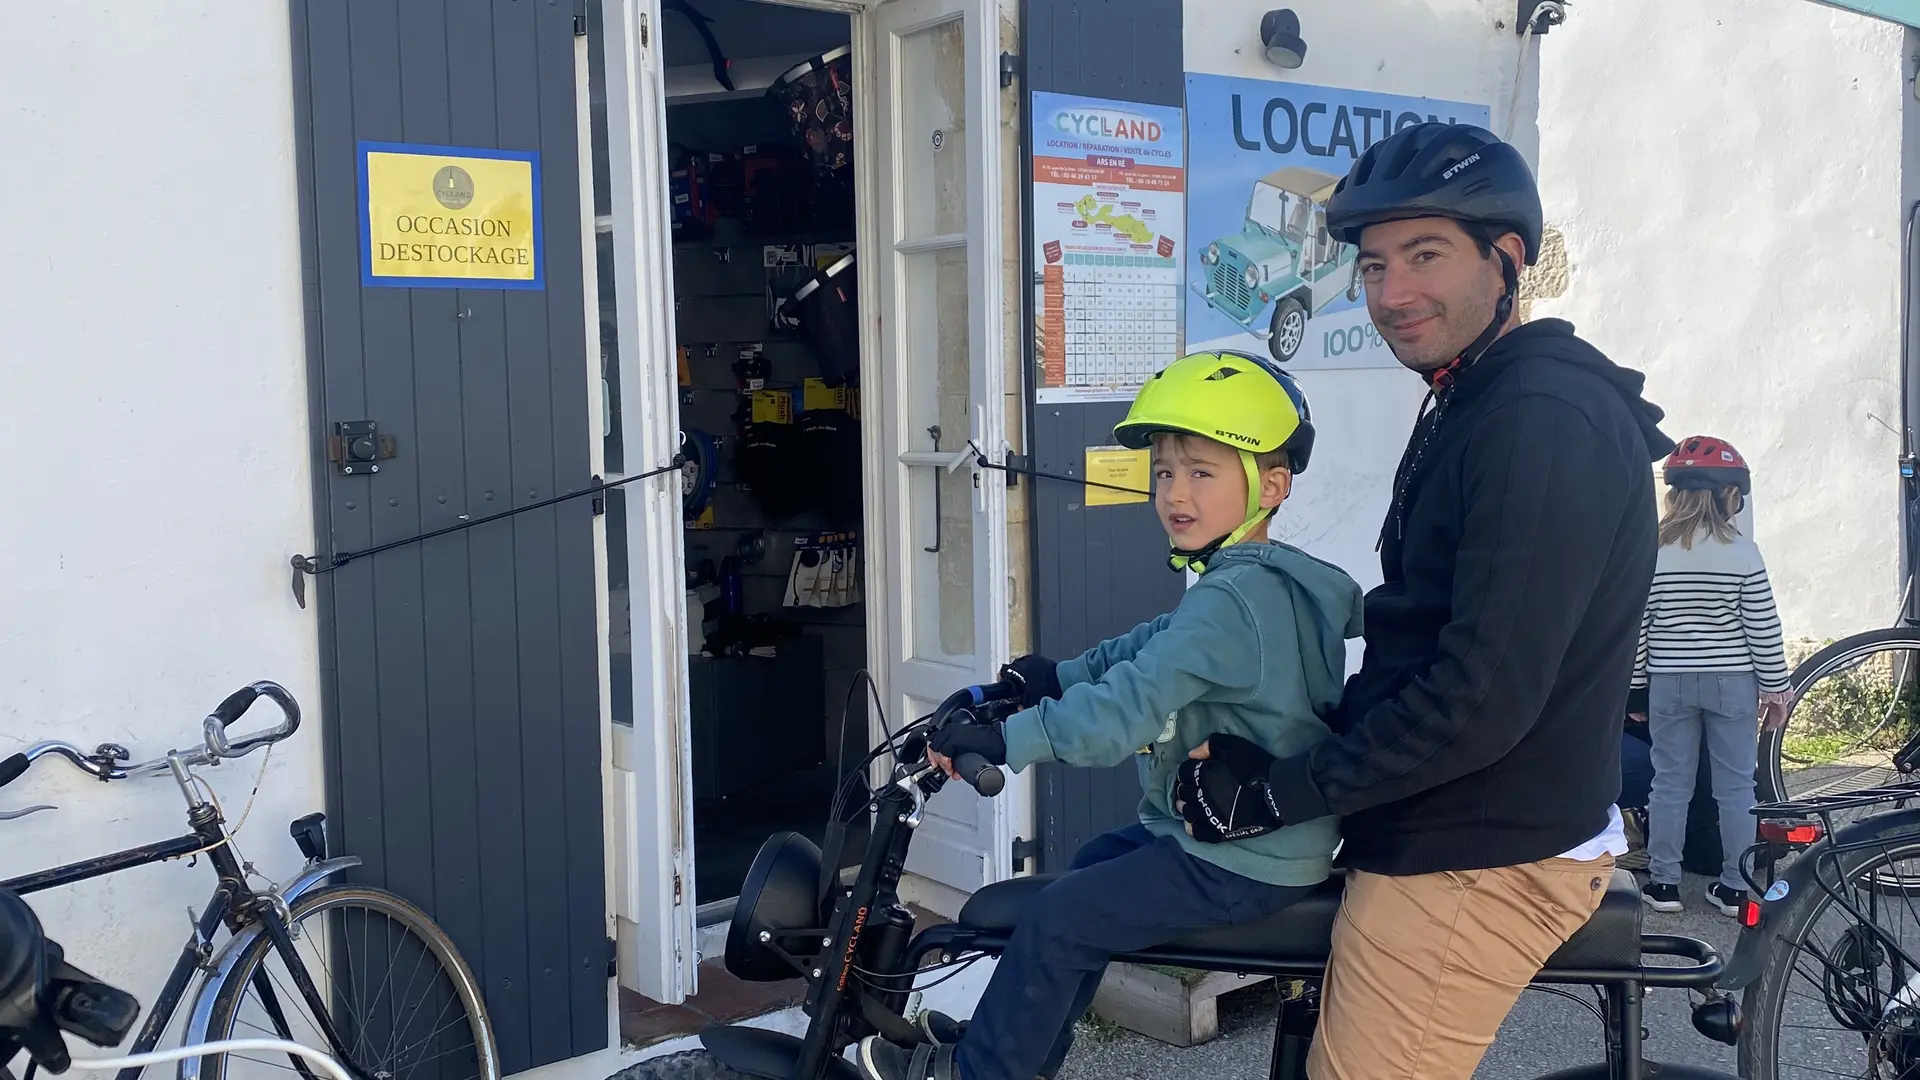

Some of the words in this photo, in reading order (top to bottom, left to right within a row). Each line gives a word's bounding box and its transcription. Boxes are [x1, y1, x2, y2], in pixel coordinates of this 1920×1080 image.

[1056, 112, 1161, 142] CYCLAND
[1047, 140, 1078, 149] LOCATION
[1083, 142, 1120, 152] RÉPARATION
[1124, 147, 1142, 155] VENTE
[1151, 150, 1172, 158] CYCLES
[1096, 157, 1109, 166] ARS
[1117, 158, 1126, 167] RÉ
[396, 215, 511, 237] OCCASION
[379, 242, 529, 265] DESTOCKAGE
[1197, 788, 1229, 834] SHOCK
[844, 906, 867, 963] CYCLAND
